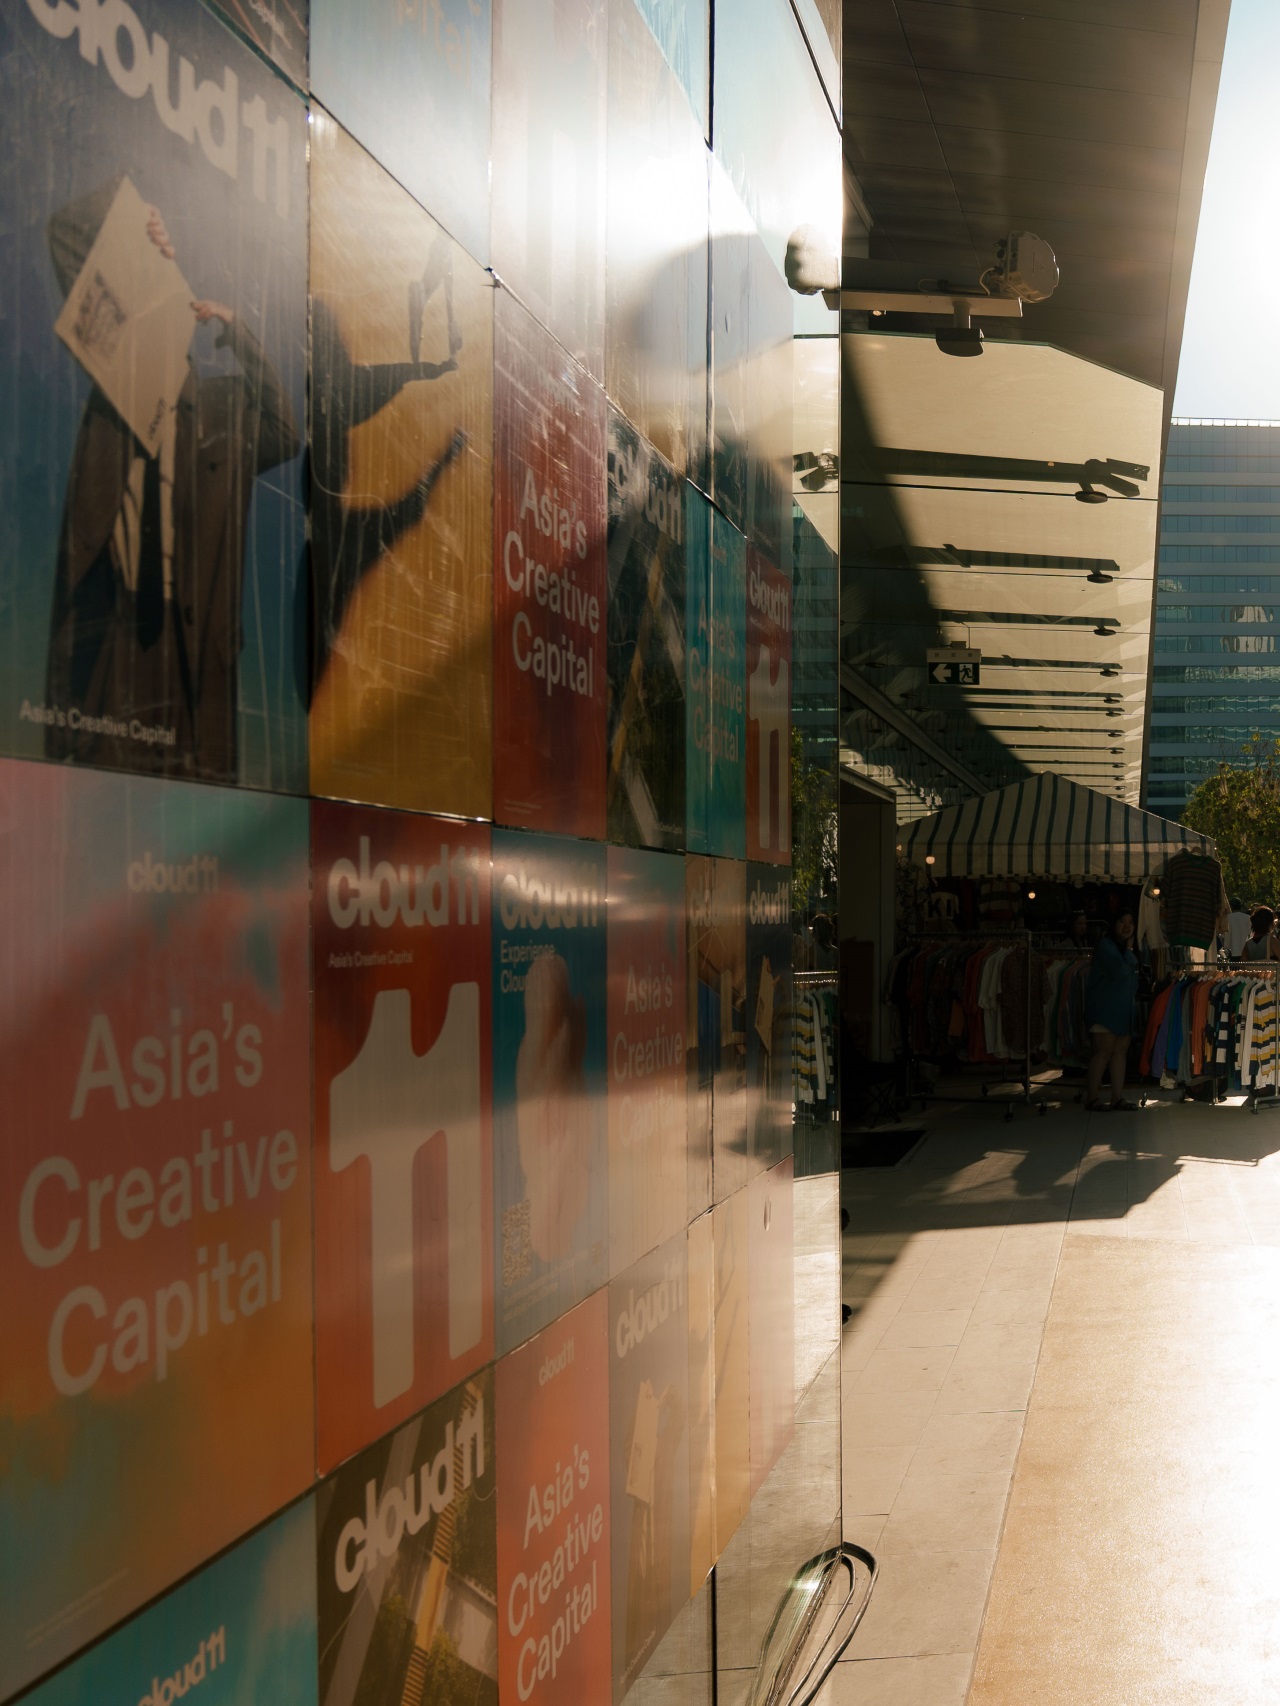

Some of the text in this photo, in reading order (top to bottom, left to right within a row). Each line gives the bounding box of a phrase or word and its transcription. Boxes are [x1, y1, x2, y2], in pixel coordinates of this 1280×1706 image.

[520, 467, 588, 560] Asia's
[503, 530, 601, 635] Creative
[511, 611, 595, 699] Capital
[20, 699, 177, 746] Asia's Creative Capital
[126, 850, 219, 894] cloud11
[328, 835, 480, 929] cloud11
[750, 879, 789, 925] cloud11
[624, 963, 673, 1016] Asia's
[69, 1002, 264, 1120] Asia's
[613, 1024, 683, 1084] Creative
[19, 1120, 298, 1268] Creative
[47, 1218, 280, 1396] Capital
[616, 1251, 683, 1359] cloud11
[335, 1388, 485, 1593] cloud11
[523, 1443, 590, 1551] Asia's
[507, 1502, 604, 1637] Creative
[516, 1560, 598, 1701] Capital
